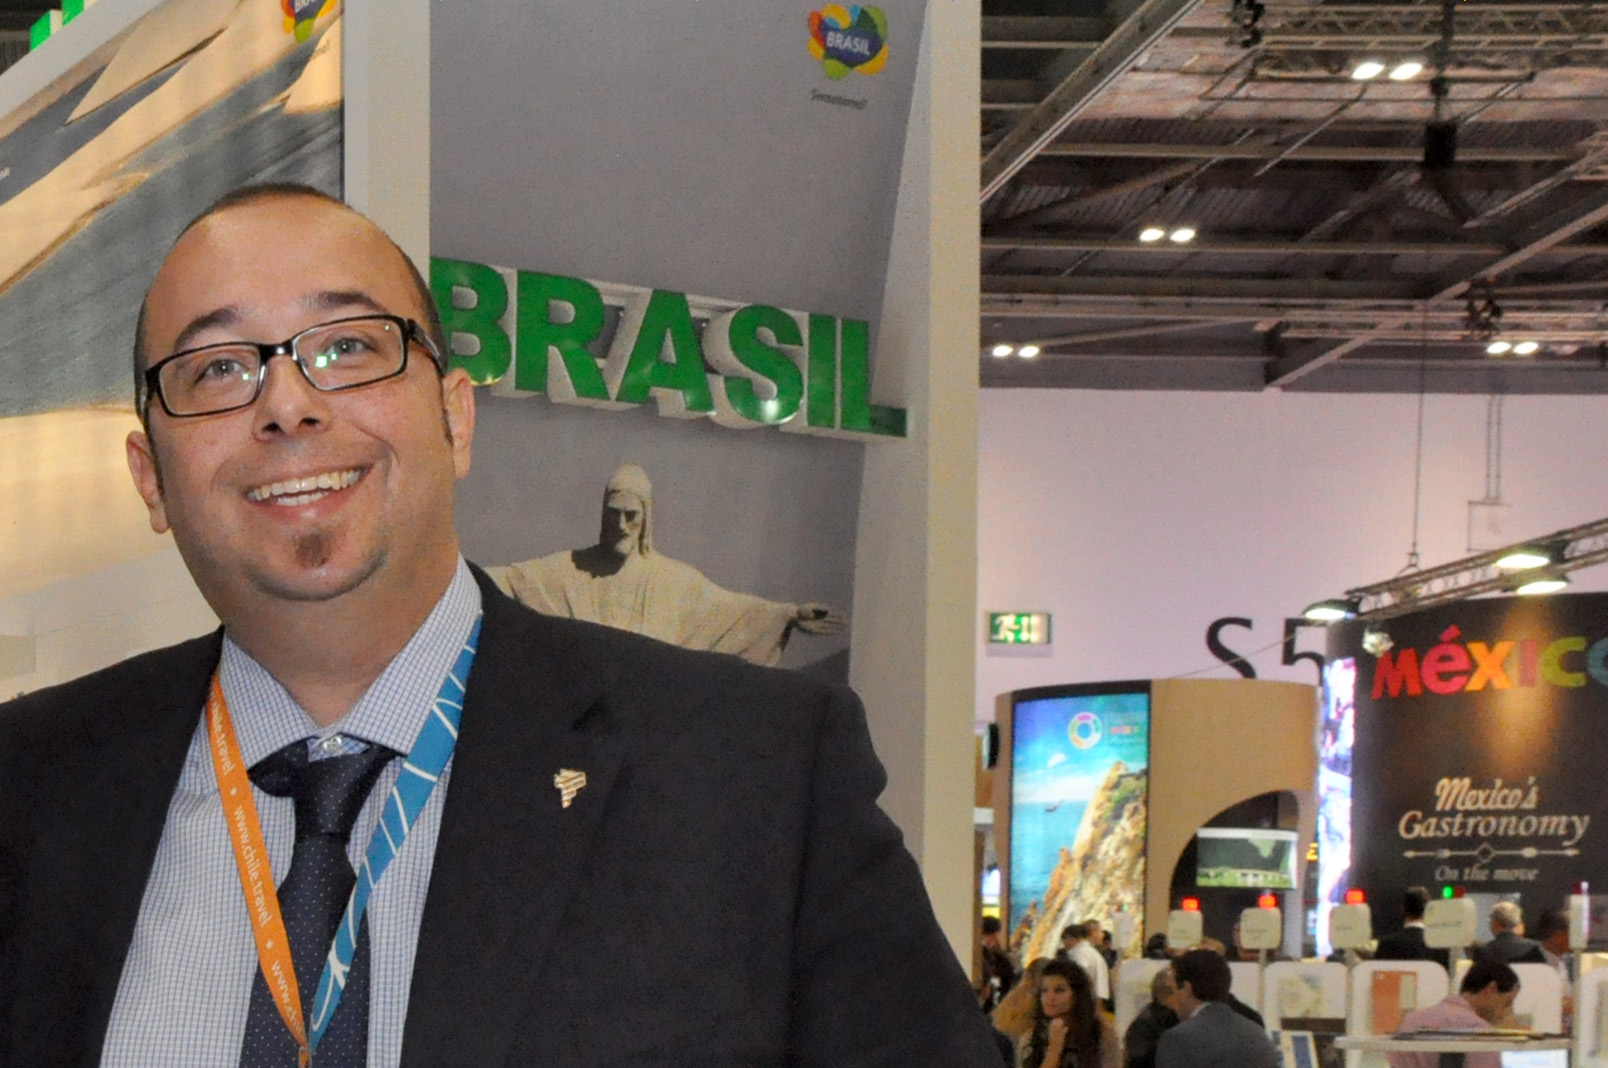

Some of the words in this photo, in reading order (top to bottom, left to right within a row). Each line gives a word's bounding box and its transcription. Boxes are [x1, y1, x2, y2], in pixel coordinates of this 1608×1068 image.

[827, 32, 871, 56] BRASIL
[429, 256, 907, 437] BRASIL
[1435, 776, 1539, 811] Mexico's
[1398, 811, 1590, 847] Gastronomy
[234, 806, 271, 928] www.chile.travel
[1435, 866, 1459, 881] On
[1463, 864, 1490, 881] the
